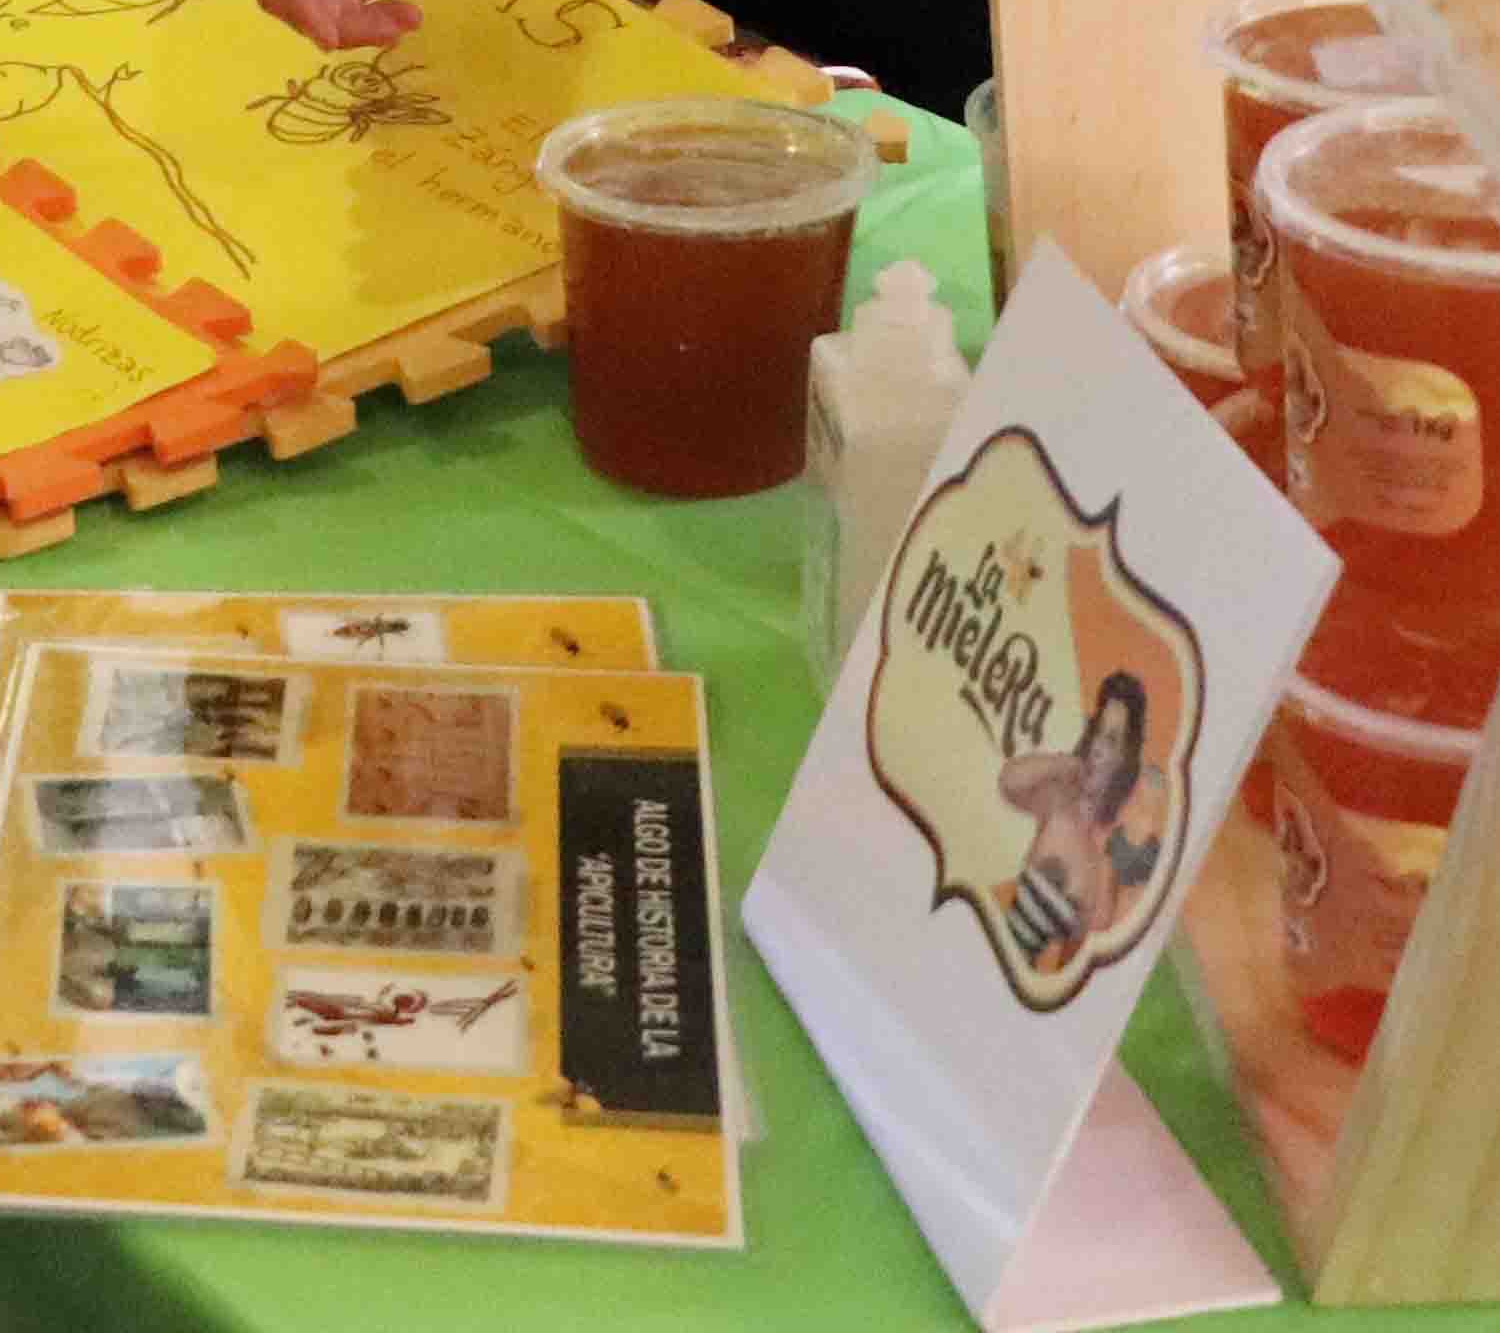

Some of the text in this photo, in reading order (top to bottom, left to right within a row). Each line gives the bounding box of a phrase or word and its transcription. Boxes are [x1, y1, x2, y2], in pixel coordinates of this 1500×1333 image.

[965, 540, 1004, 610] La
[633, 797, 682, 1059] ALGO DE HISTORIA DE LA
